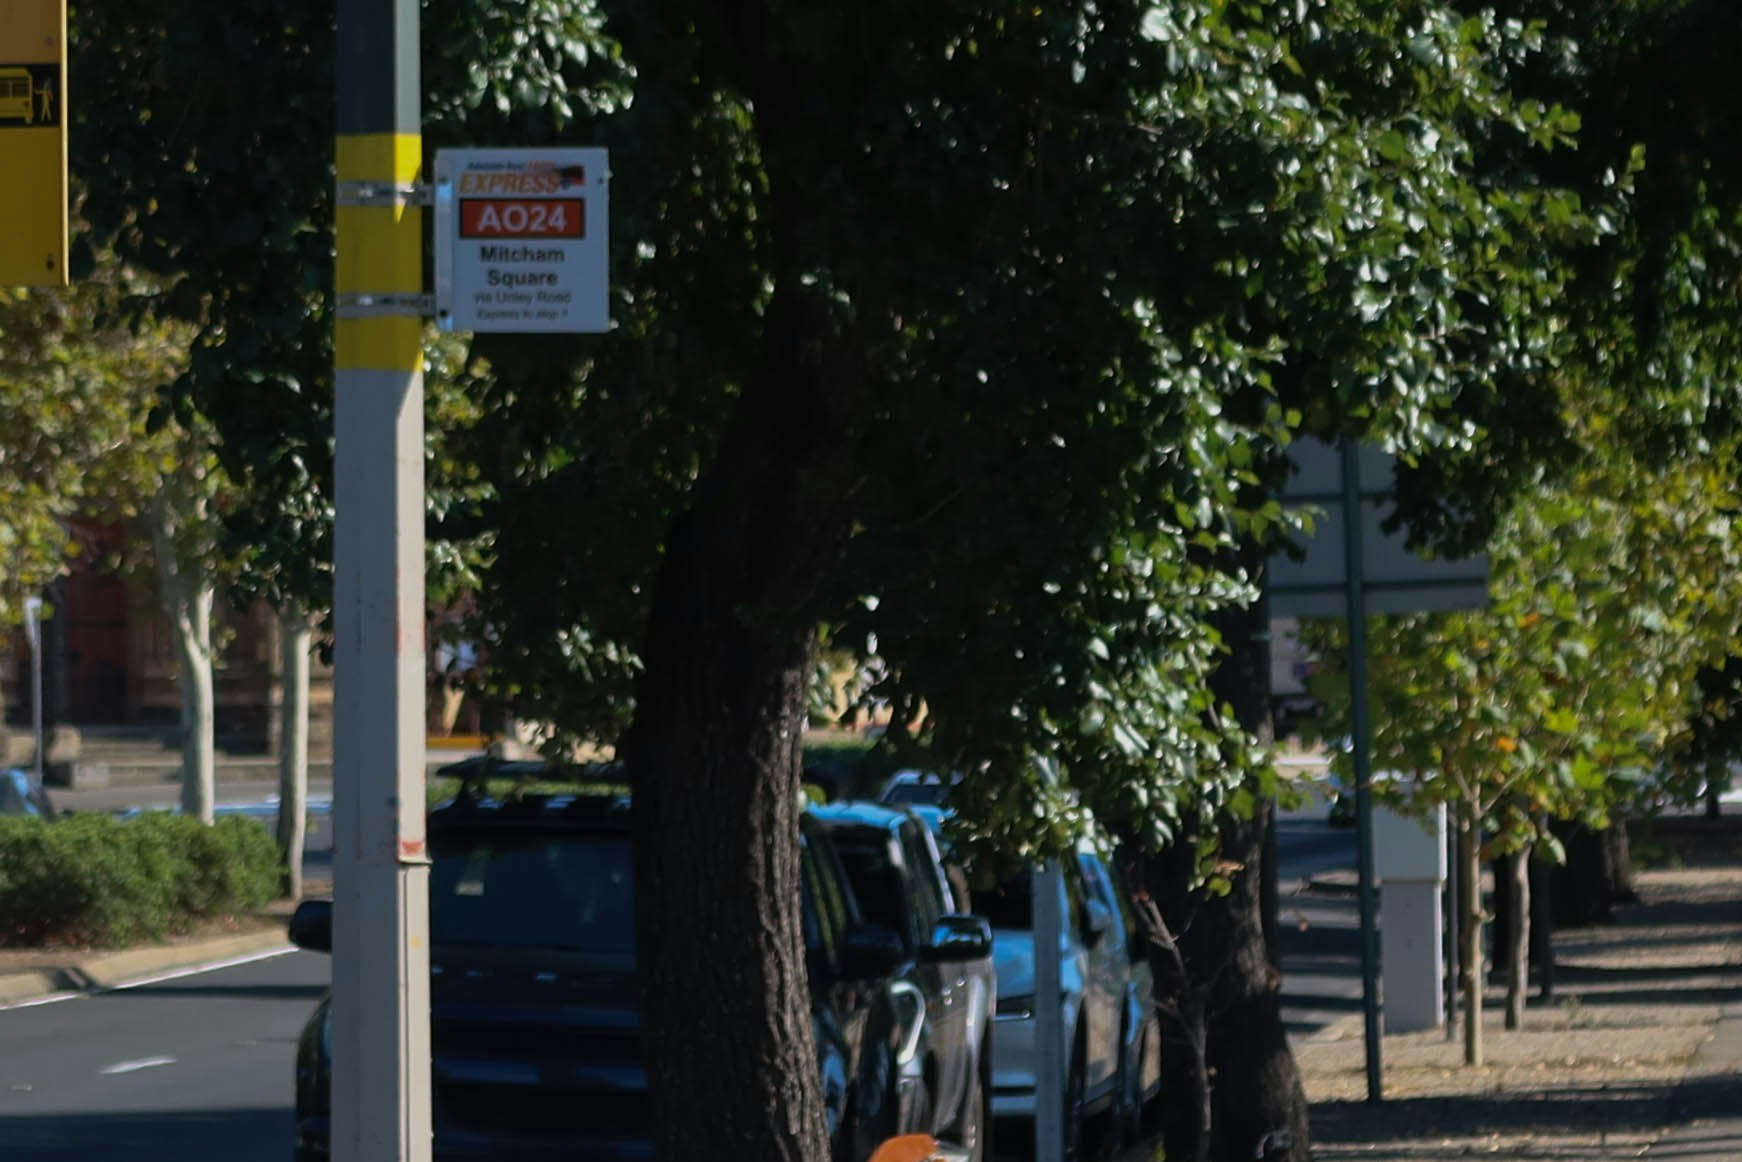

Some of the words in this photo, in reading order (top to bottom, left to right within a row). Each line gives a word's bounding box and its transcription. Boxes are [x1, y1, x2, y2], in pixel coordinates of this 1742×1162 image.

[459, 172, 561, 193] EXPRESS
[477, 204, 567, 231] AO24
[480, 246, 565, 263] Mitcham
[487, 269, 559, 288] Square
[474, 291, 492, 304] via
[537, 290, 572, 304] Road
